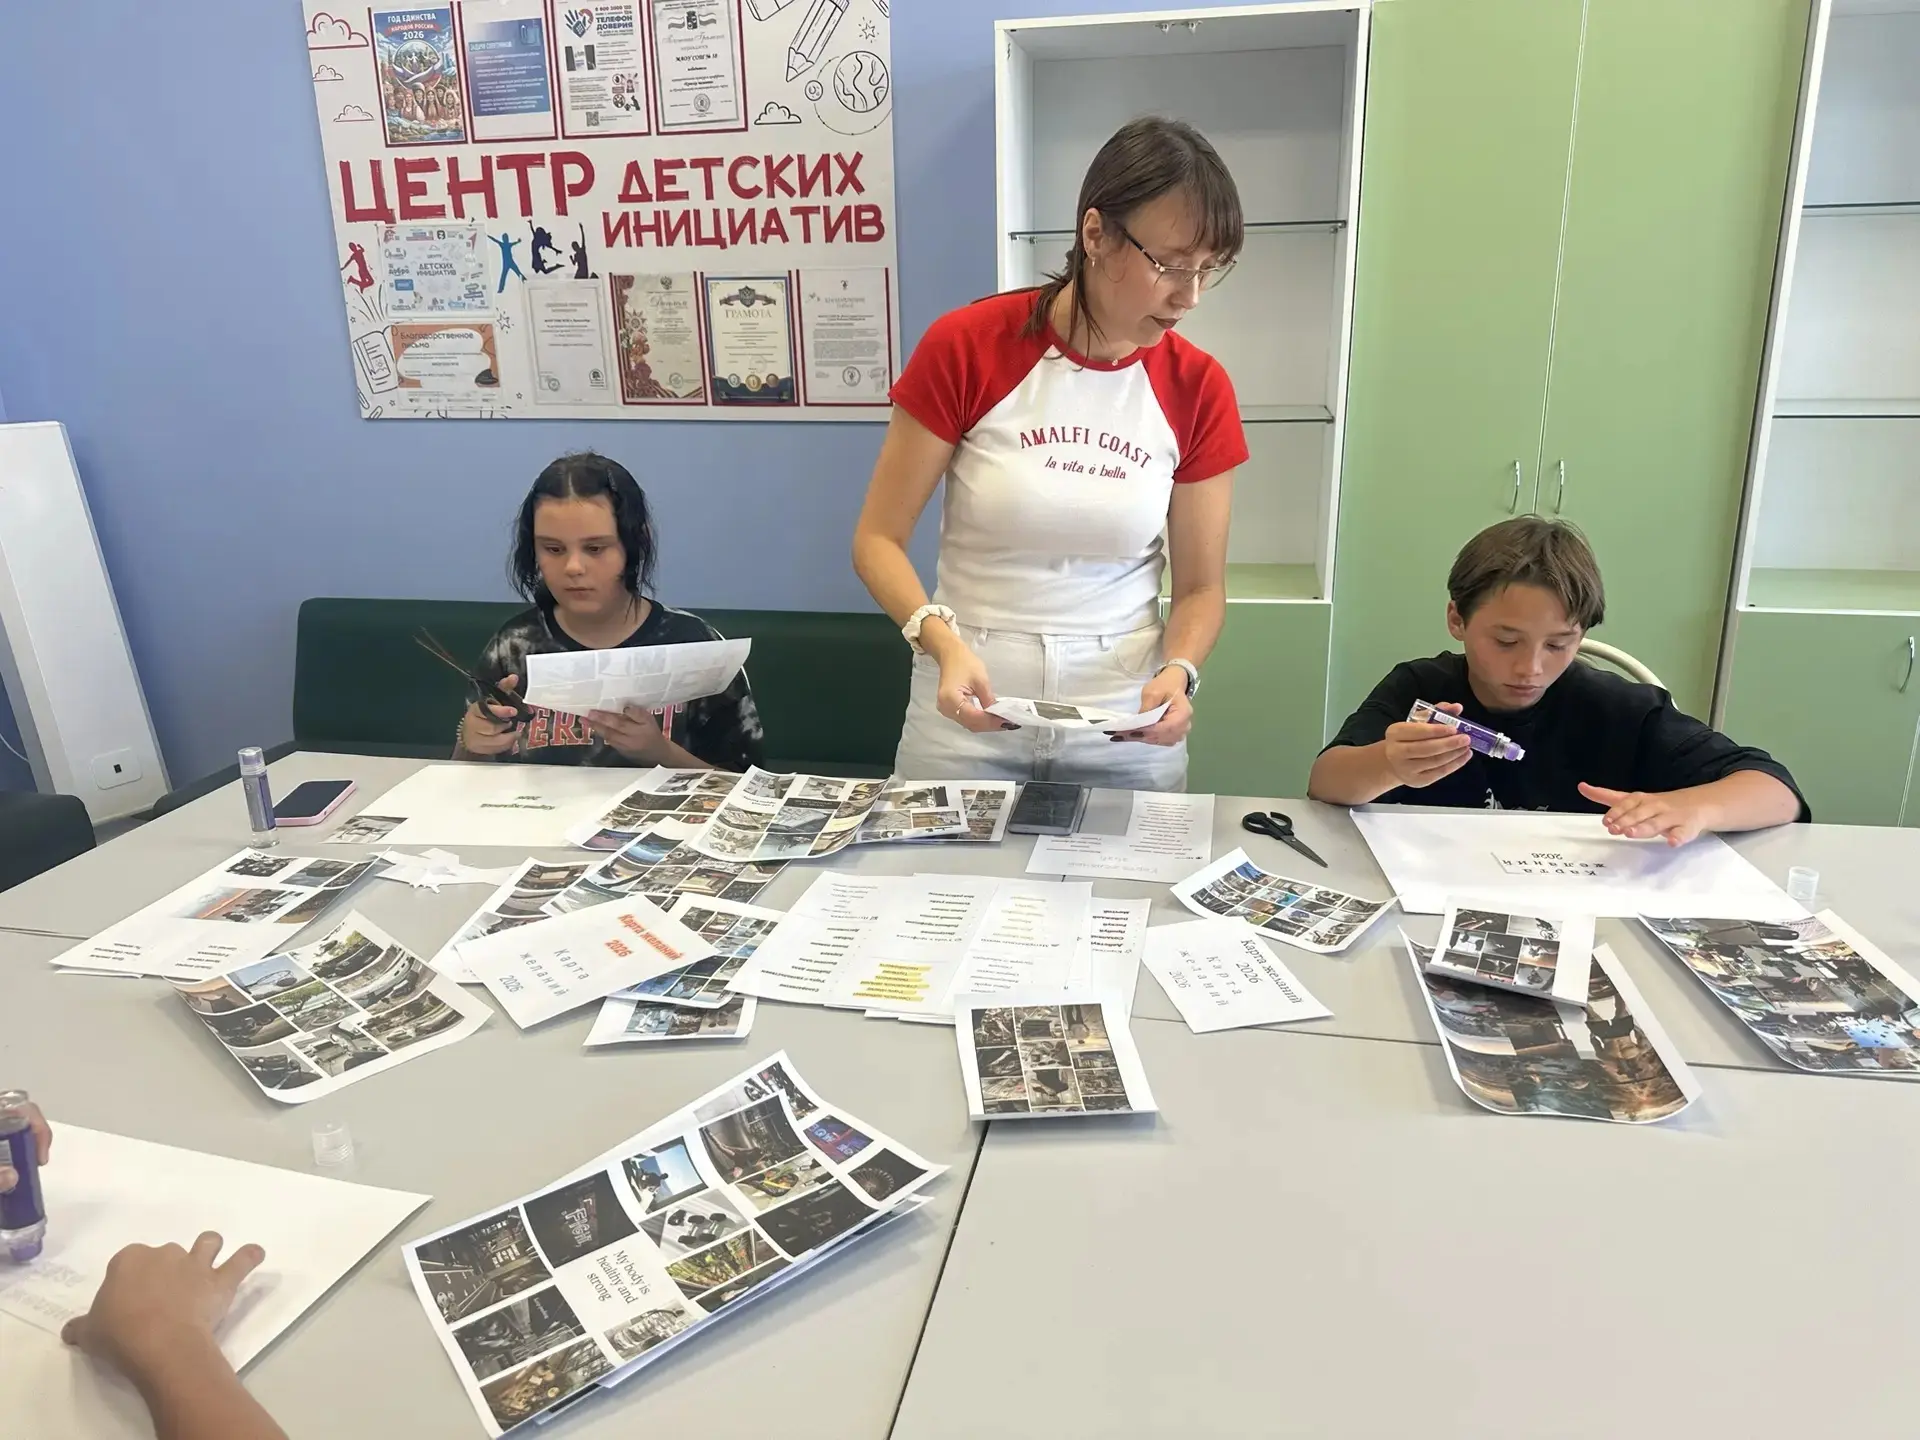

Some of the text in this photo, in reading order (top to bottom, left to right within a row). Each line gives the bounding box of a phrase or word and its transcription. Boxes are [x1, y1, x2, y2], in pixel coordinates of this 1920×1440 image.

[388, 12, 436, 24] ГОД ЕДИНСТВА
[596, 15, 632, 24] ТЕЛЕФОН
[596, 22, 632, 31] ДОВЕРИЯ
[402, 30, 424, 40] 2026
[339, 151, 595, 224] ЦЕНТР
[618, 151, 866, 203] ДЕТСКИХ
[602, 203, 885, 250] ИНИЦИАТИВ
[419, 262, 454, 270] ДЕТСКИХ
[724, 308, 773, 319] ГРАМОТА
[1020, 426, 1152, 469] AMALFI COAST
[1044, 456, 1057, 468] la
[1062, 460, 1084, 474] vita
[1100, 464, 1126, 480] bella
[1502, 859, 1607, 868] желаний
[1531, 852, 1564, 860] 2026
[1523, 868, 1598, 877] Карта
[604, 939, 636, 958] 2026
[618, 912, 685, 962] Карта желаний
[519, 952, 570, 998] желаний
[554, 948, 590, 981] Карта
[1206, 956, 1243, 996] Карта
[1235, 962, 1264, 985] 2026
[1240, 938, 1304, 1004] Карта желаний
[498, 974, 526, 994] 2026
[1168, 969, 1192, 989] 2026
[1178, 948, 1230, 1006] желаний
[596, 1255, 640, 1304] healthy and
[613, 1250, 650, 1296] My body is
[586, 1272, 612, 1302] strong
